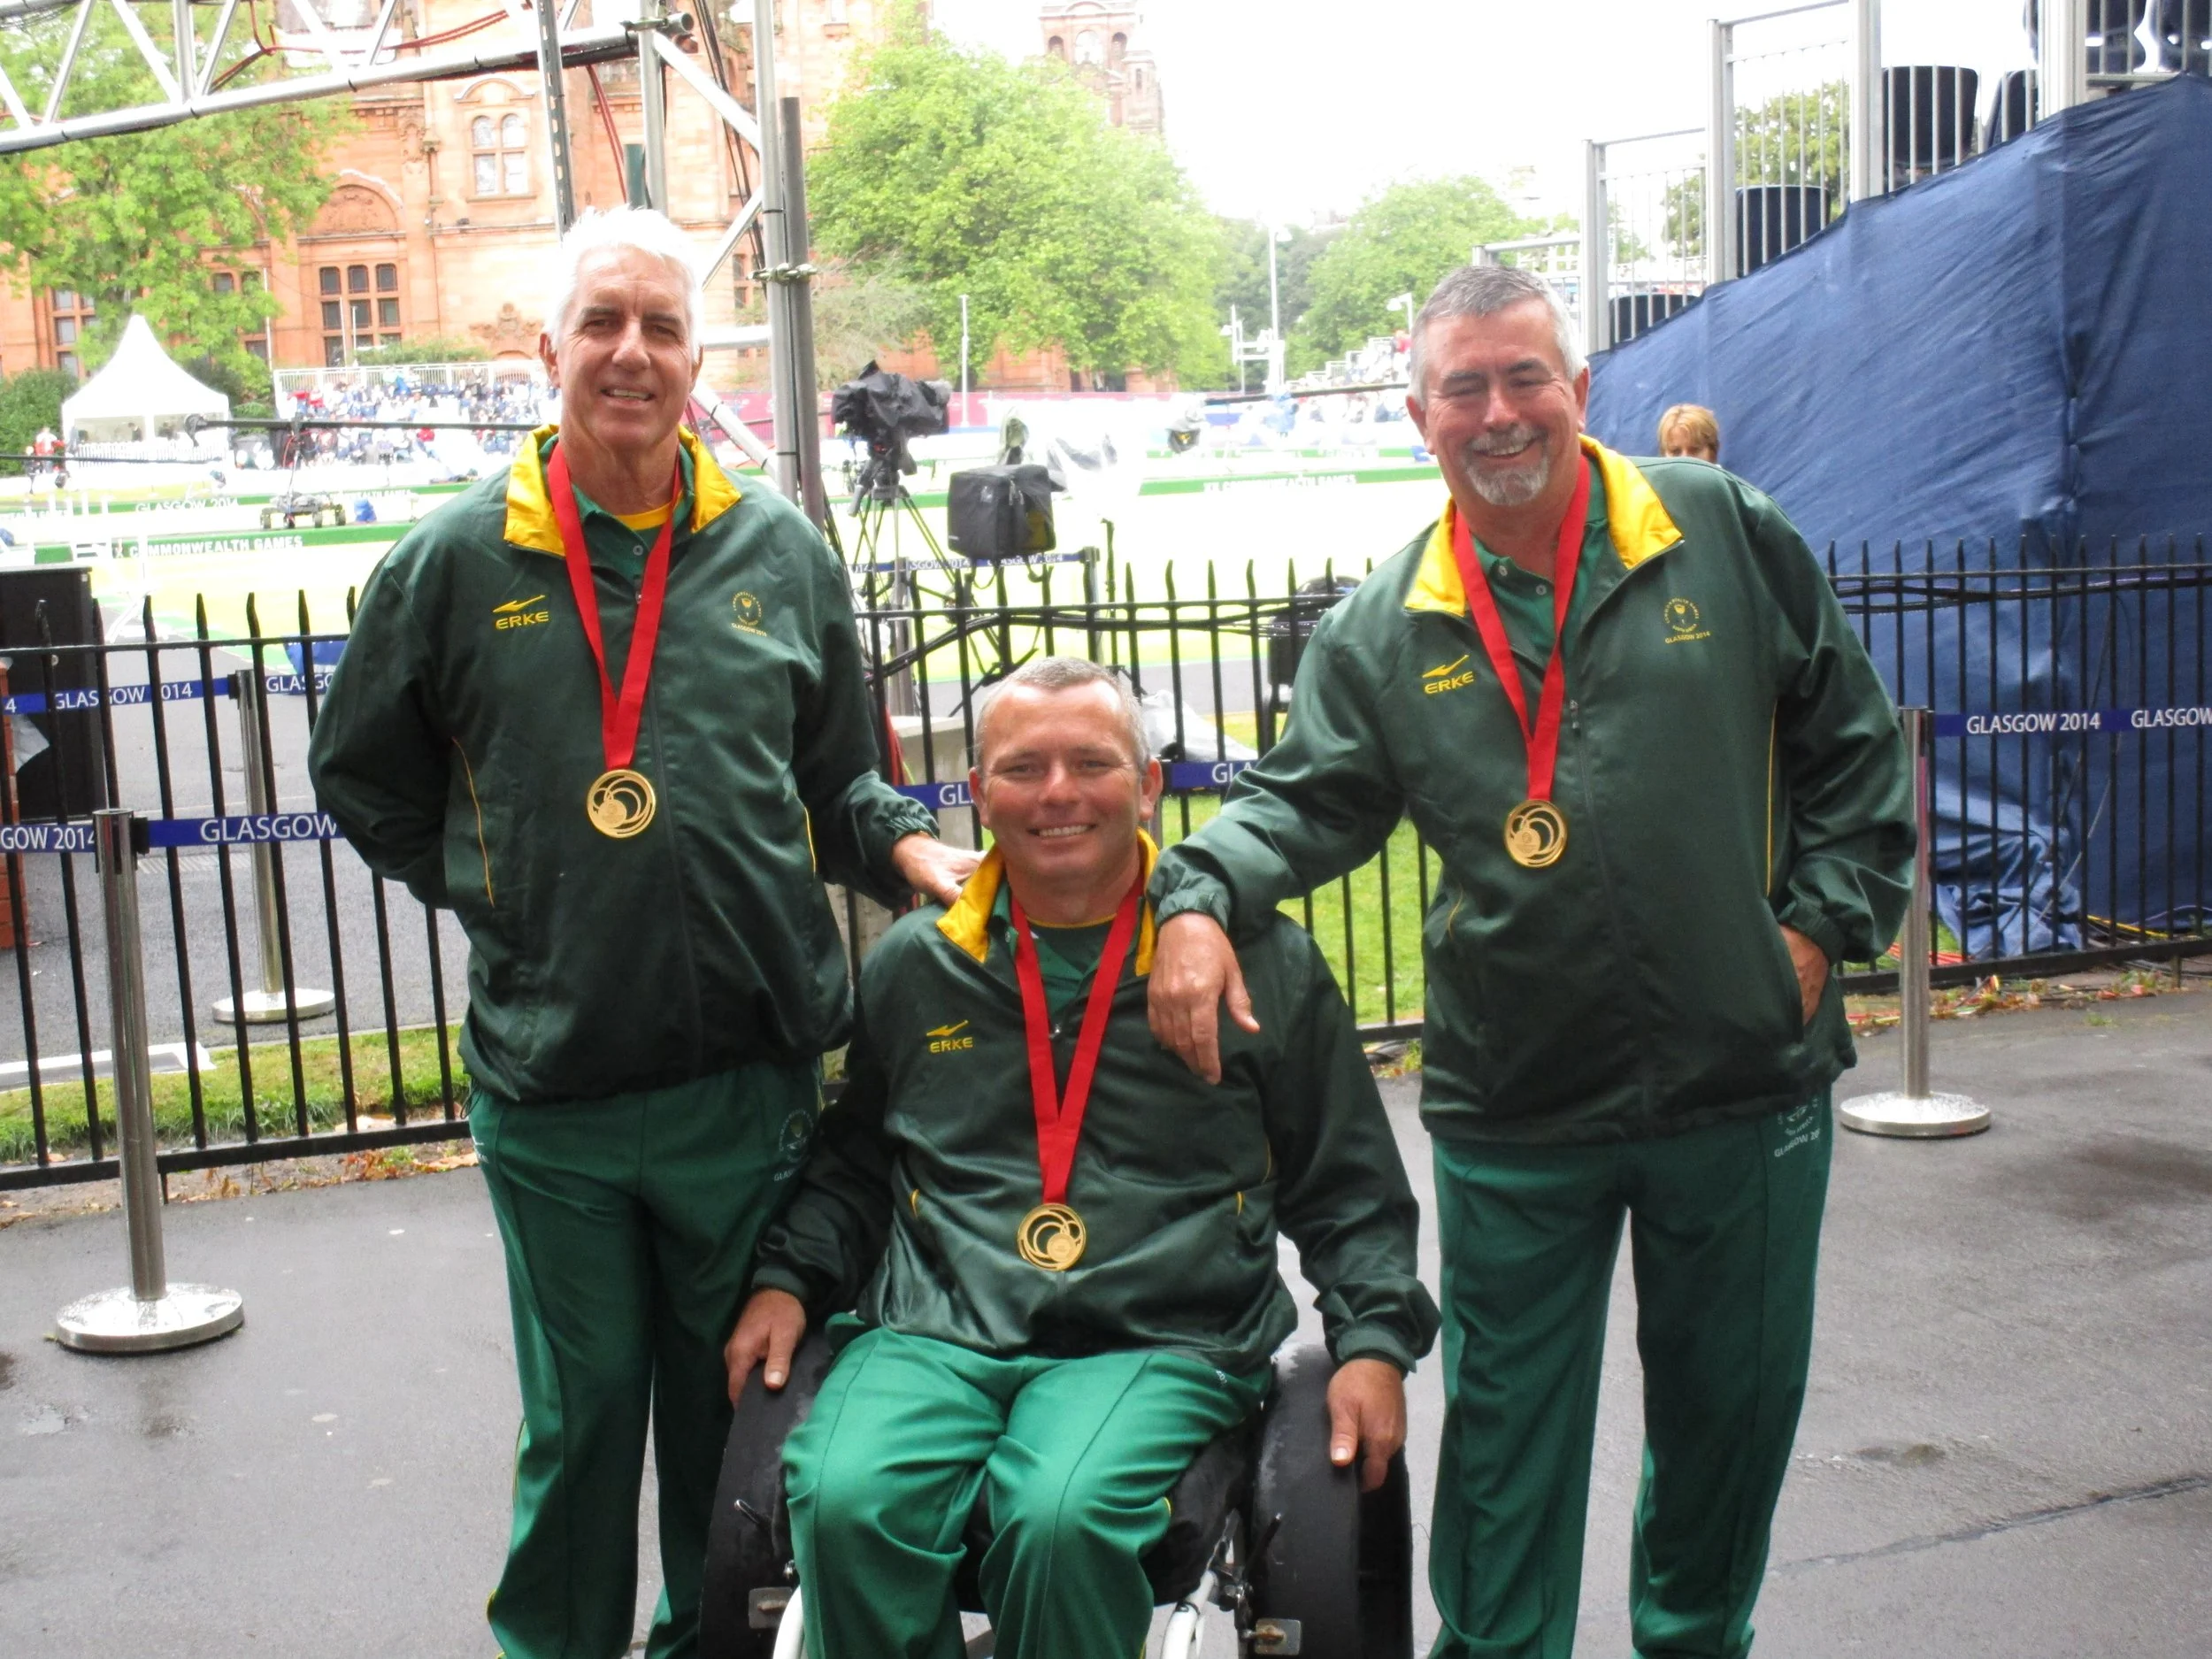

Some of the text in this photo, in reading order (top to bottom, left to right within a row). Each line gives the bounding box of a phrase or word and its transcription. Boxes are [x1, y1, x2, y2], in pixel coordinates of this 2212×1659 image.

[130, 538, 250, 558] CMMONWEALTH
[254, 535, 303, 550] GAMES
[495, 611, 549, 630] ERKE
[1424, 671, 1475, 695] ERKE
[55, 682, 192, 710] GLASOW 014
[1966, 711, 2101, 734] GLASGOW 2014
[2131, 707, 2212, 729] GLASGOW
[200, 814, 337, 842] GLASGOW
[929, 1036, 974, 1054] ERKE
